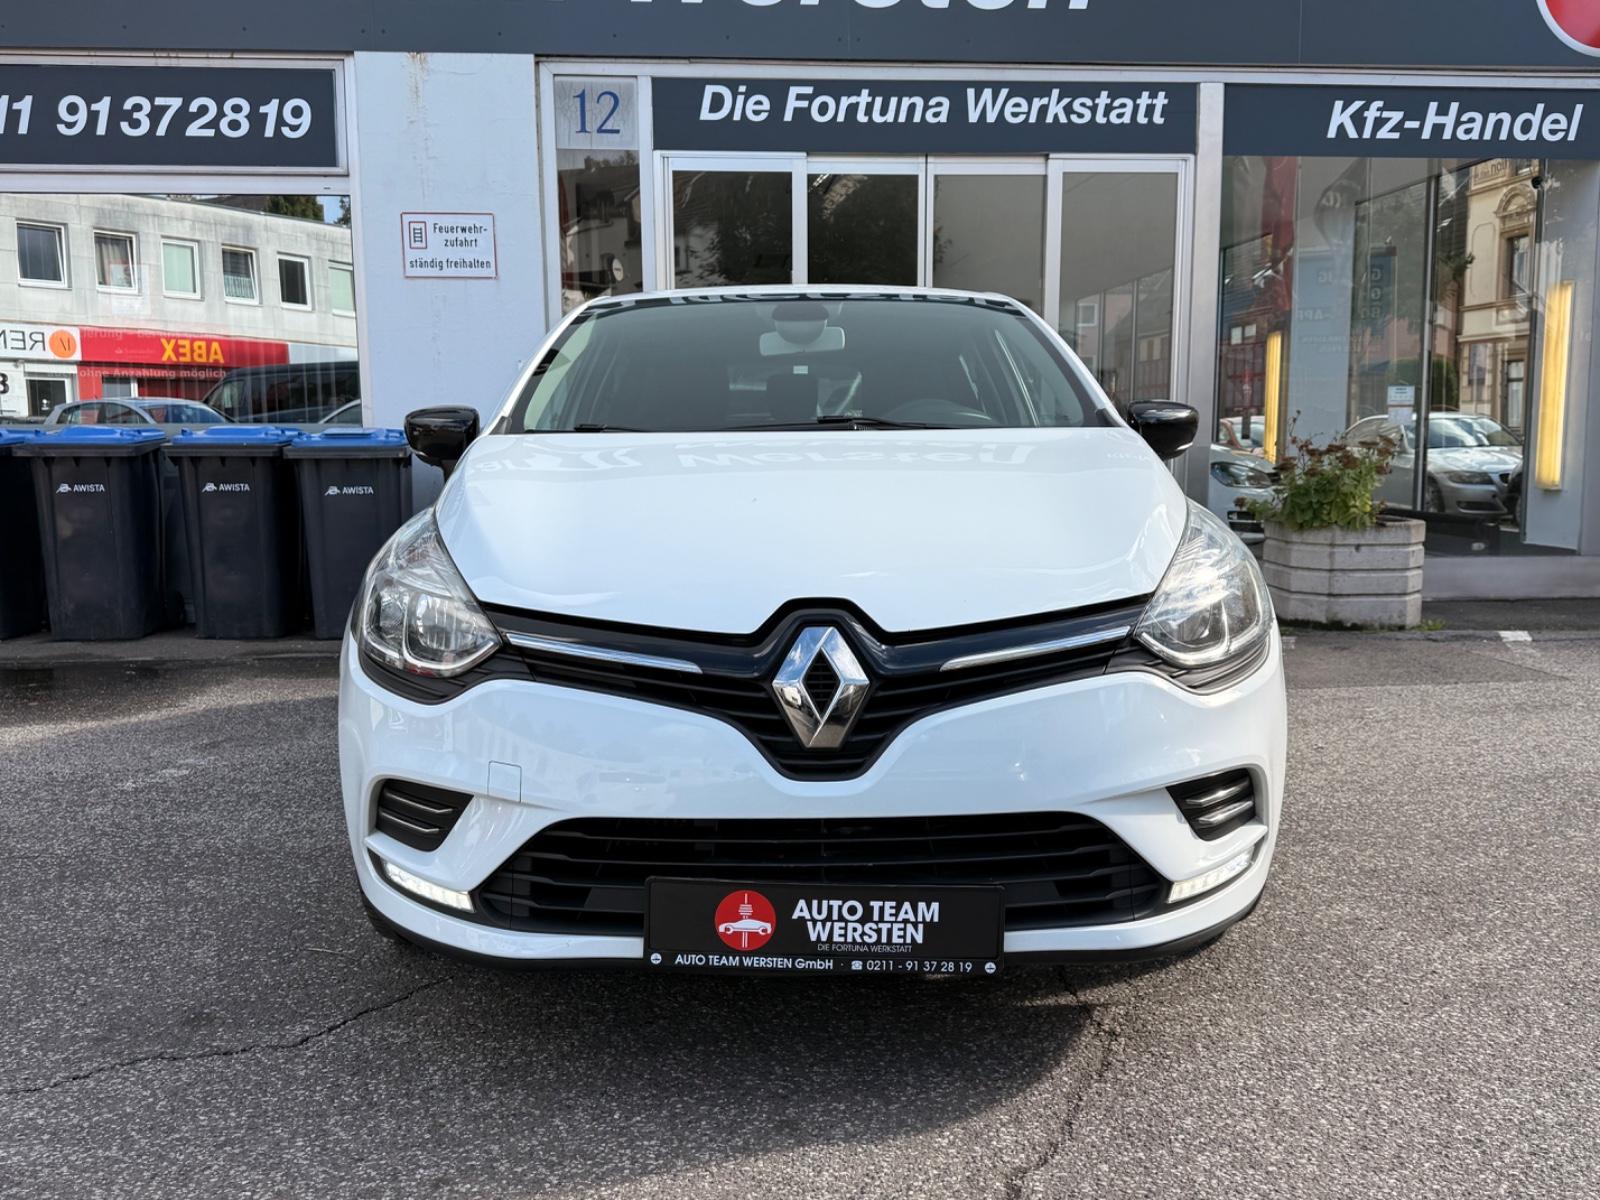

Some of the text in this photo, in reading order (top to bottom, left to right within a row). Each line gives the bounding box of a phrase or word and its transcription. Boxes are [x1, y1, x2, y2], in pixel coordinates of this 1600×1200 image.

[572, 88, 621, 134] 12
[699, 84, 1169, 124] Die Fortuna Werkstatt
[56, 95, 312, 139] 91372819
[1326, 100, 1584, 141] Kfz-Handel
[433, 222, 488, 234] Feuerwehr-
[444, 236, 478, 248] zufahrt
[409, 257, 491, 271] ständig freihalten
[113, 367, 176, 379] Anzahlung
[179, 367, 226, 379] möglich
[73, 483, 105, 493] AWISTA
[219, 482, 250, 492] AWISTA
[342, 485, 374, 495] AWISTA
[791, 899, 940, 923] AUTO TEAM
[806, 921, 924, 944] WERSTEN
[817, 943, 912, 953] DIE FORTUNA WERKSTATT
[674, 954, 834, 970] AUTO TEAM WERSTEN GmbH
[866, 959, 894, 971] 0211
[905, 960, 919, 971] 91
[923, 961, 937, 972] 37
[940, 961, 955, 972] 28
[959, 962, 973, 973] 19
